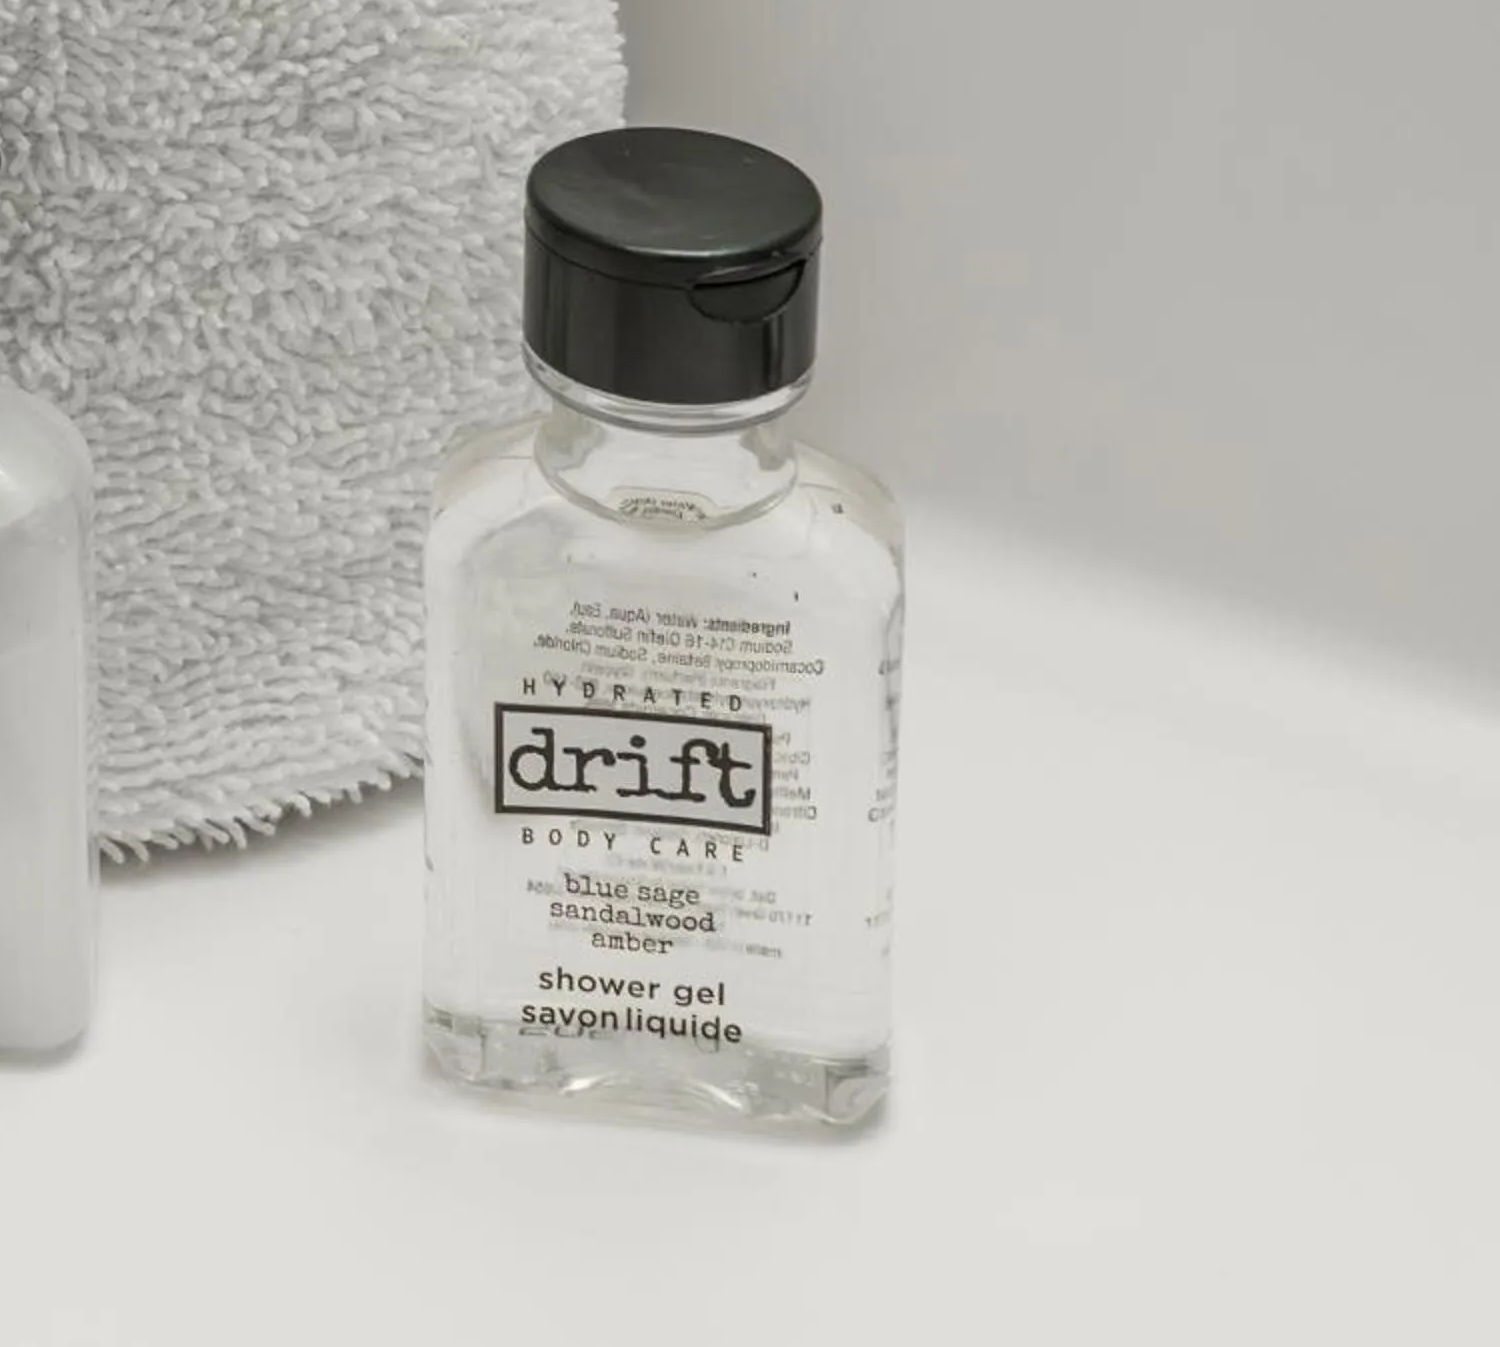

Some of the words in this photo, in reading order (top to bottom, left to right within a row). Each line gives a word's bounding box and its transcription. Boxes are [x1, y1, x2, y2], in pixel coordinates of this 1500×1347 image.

[522, 677, 743, 713] HYDRATED
[508, 726, 757, 809] drift
[521, 826, 617, 852] BODY
[650, 836, 745, 864] CARE
[563, 872, 629, 900] blue
[636, 880, 701, 907] sage
[549, 897, 716, 934] sandalwood
[591, 931, 674, 956] amber
[538, 966, 661, 1001] shower
[673, 981, 726, 1008] gel
